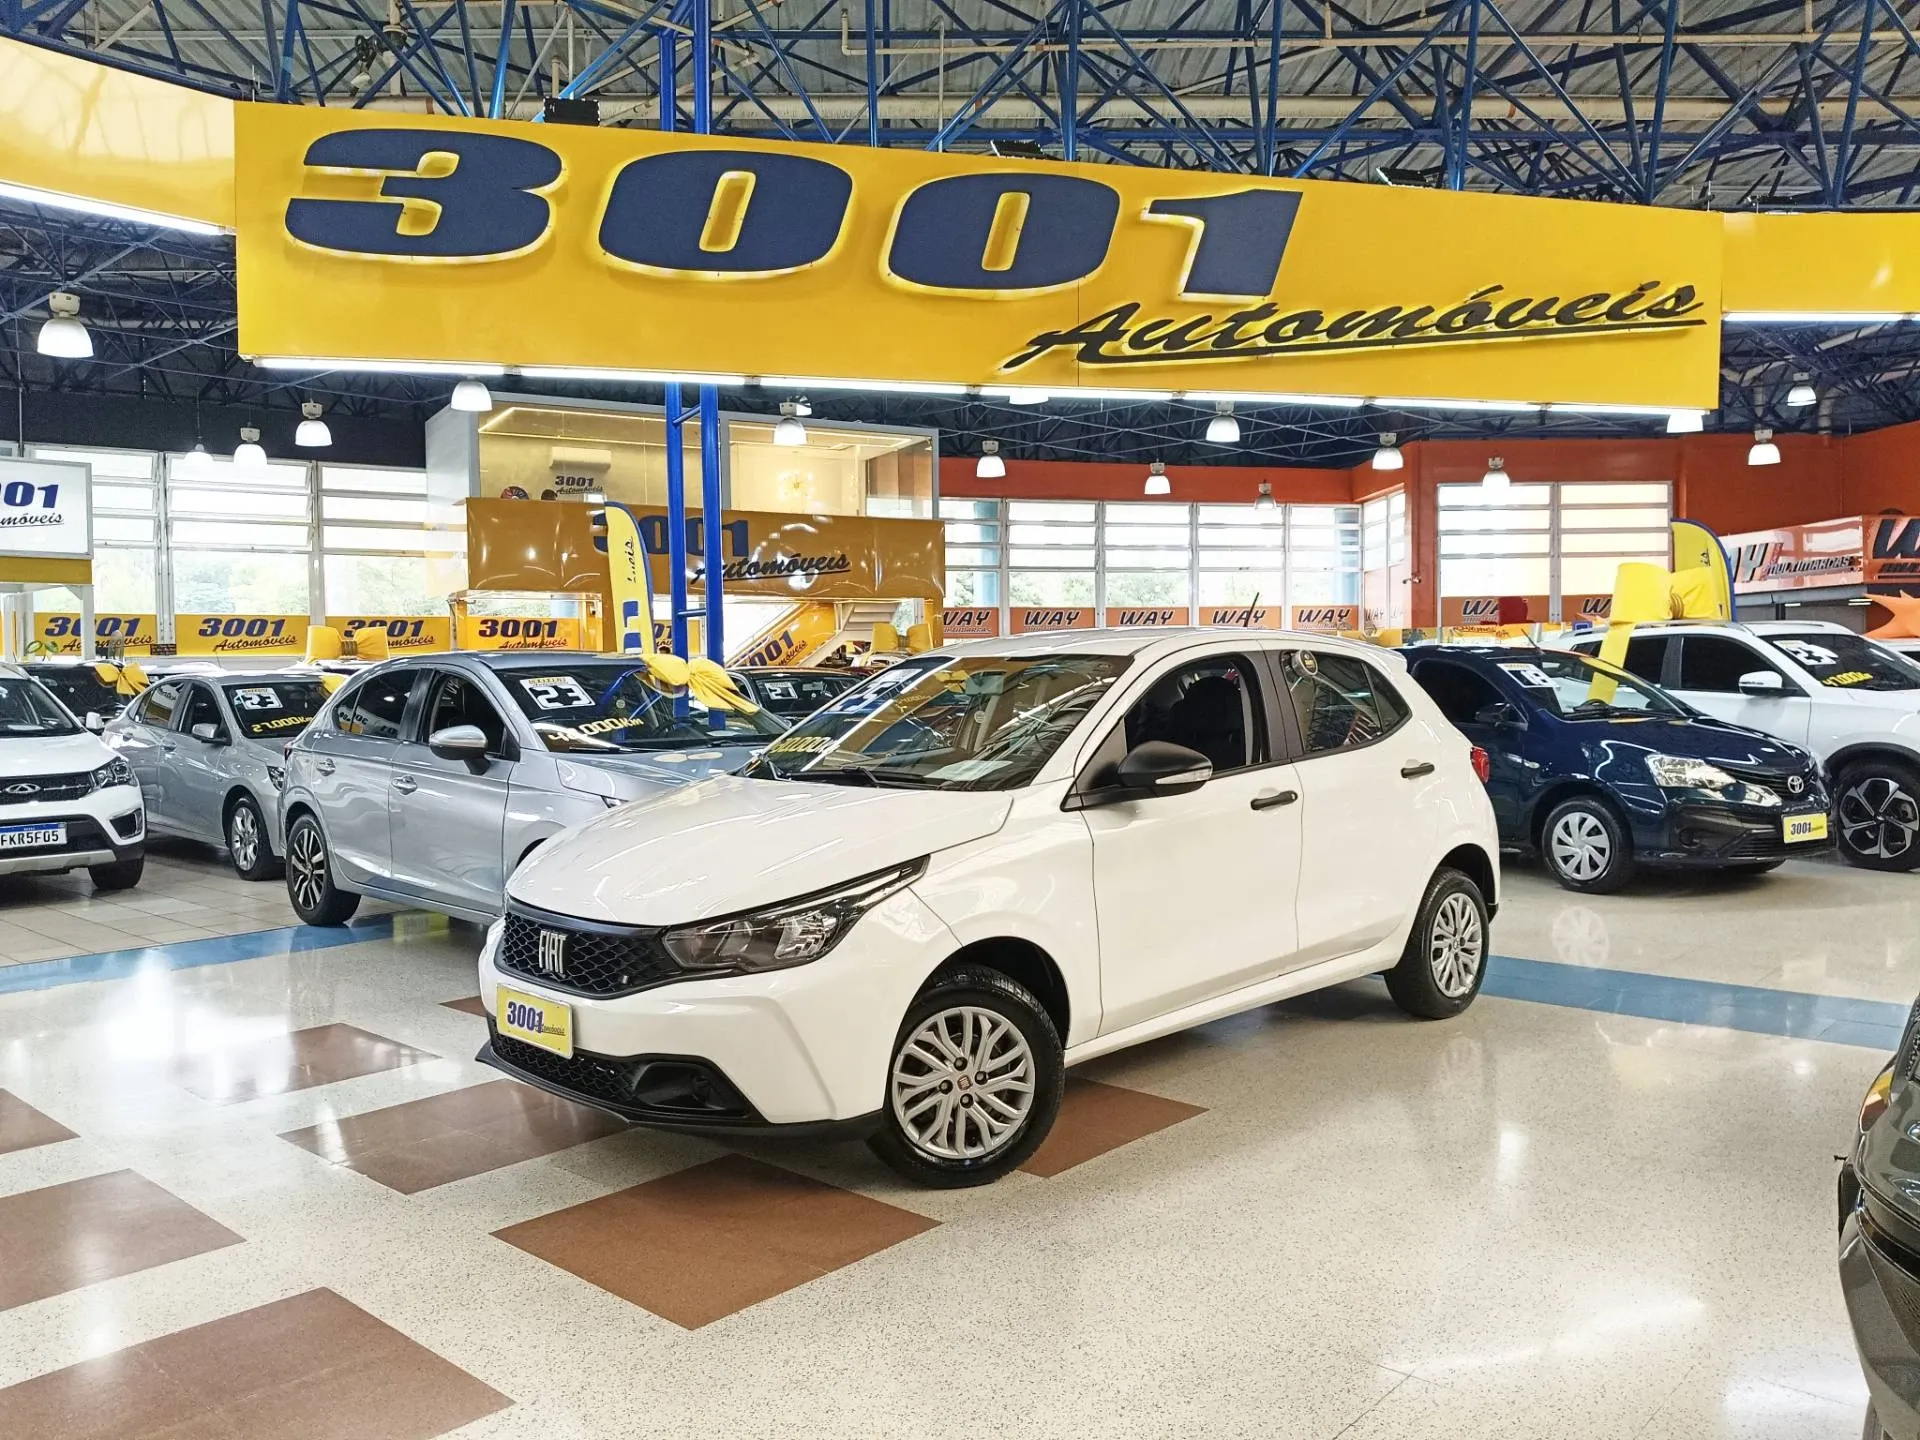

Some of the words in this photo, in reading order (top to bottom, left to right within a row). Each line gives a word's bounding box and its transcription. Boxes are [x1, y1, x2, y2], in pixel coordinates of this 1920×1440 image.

[285, 128, 1304, 301] 3001
[1002, 280, 1707, 370] Automóveis
[555, 476, 595, 487] 3001
[0, 481, 59, 509] 01
[1024, 611, 1080, 626] WAY
[1120, 611, 1174, 625] WAY
[1212, 610, 1266, 624] WAY
[1297, 609, 1351, 624] WAY
[199, 617, 286, 637] 3001
[479, 619, 558, 638] 3001
[212, 635, 298, 652] Automóveis
[536, 685, 592, 707] 23
[1790, 821, 1812, 835] 3001
[538, 928, 567, 975] FIAT
[507, 1000, 544, 1034] 3001
